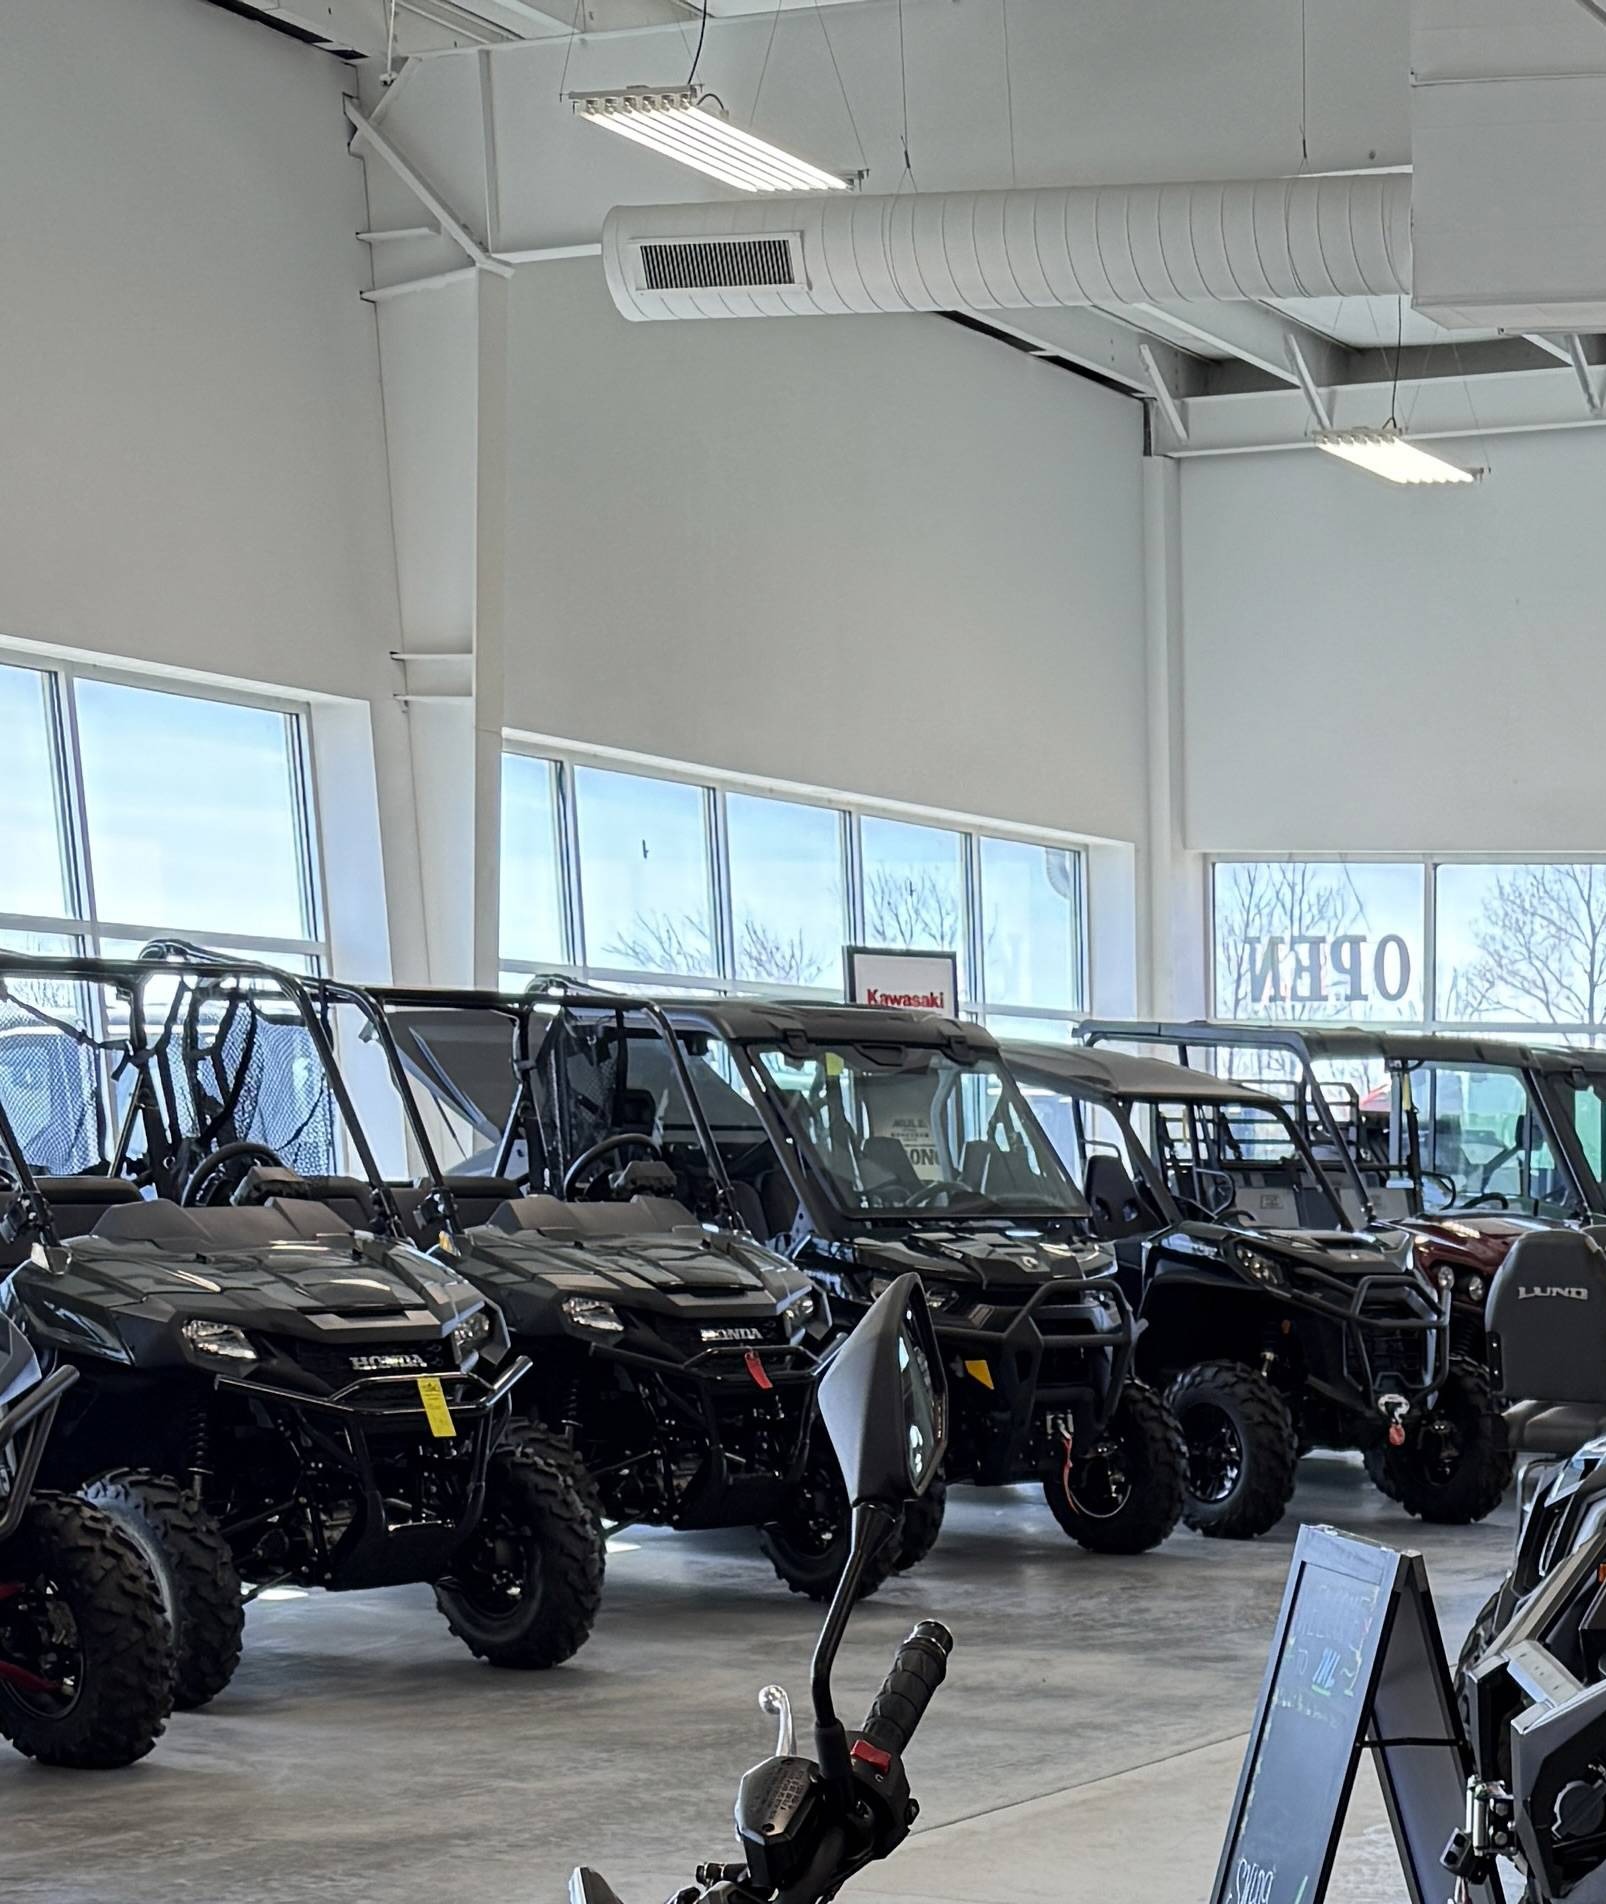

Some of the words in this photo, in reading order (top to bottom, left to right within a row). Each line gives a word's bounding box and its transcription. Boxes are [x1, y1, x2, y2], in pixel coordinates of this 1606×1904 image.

[866, 988, 945, 1009] Kawasaki
[1518, 1286, 1589, 1300] LUND
[348, 1353, 428, 1370] HONDA
